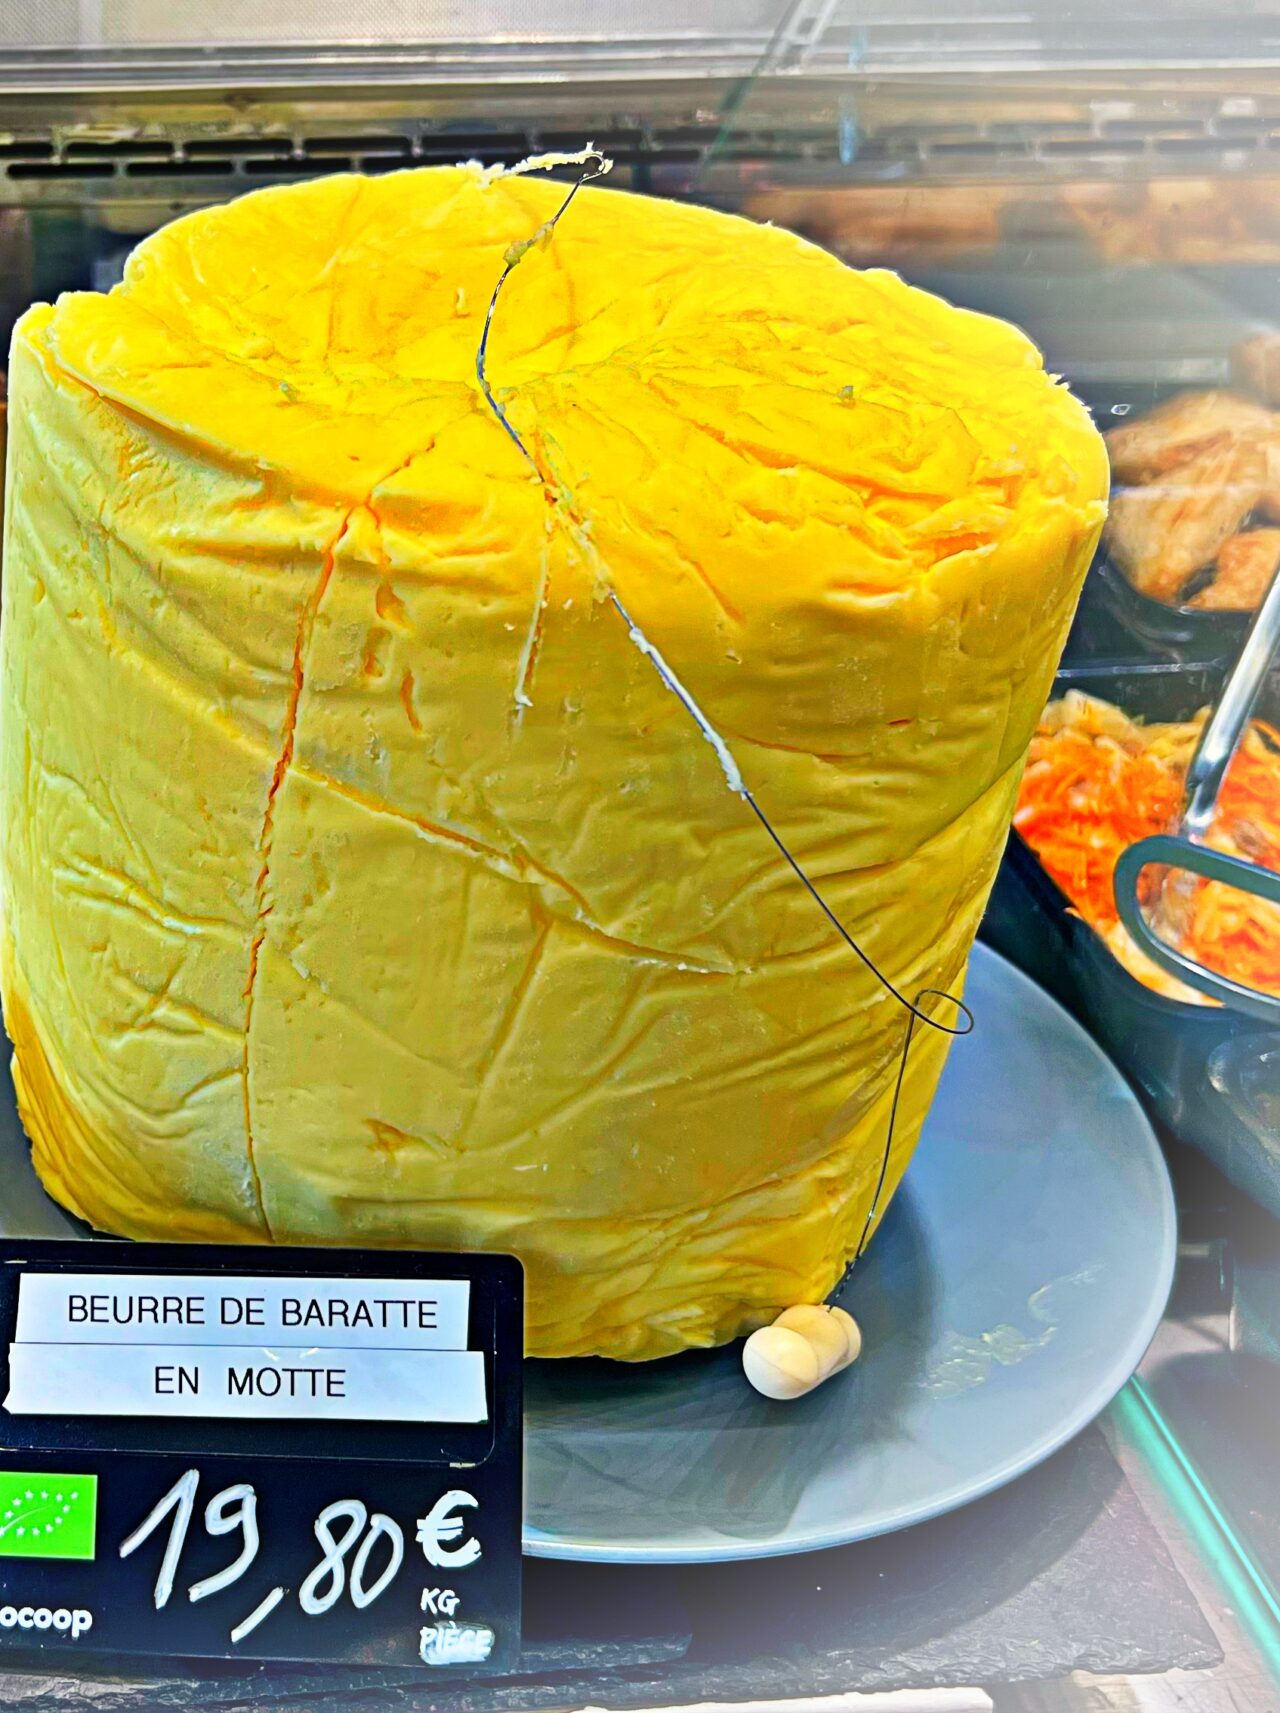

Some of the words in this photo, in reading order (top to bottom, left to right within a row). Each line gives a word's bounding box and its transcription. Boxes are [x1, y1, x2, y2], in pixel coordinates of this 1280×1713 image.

[67, 1294, 206, 1326] BEURRE
[219, 1297, 266, 1327] DE
[280, 1298, 439, 1330] BARATTE
[153, 1366, 200, 1396] EN
[227, 1367, 347, 1398] MOTTE
[119, 1467, 405, 1645] 19,80
[416, 1489, 483, 1569] €
[420, 1587, 460, 1616] KG
